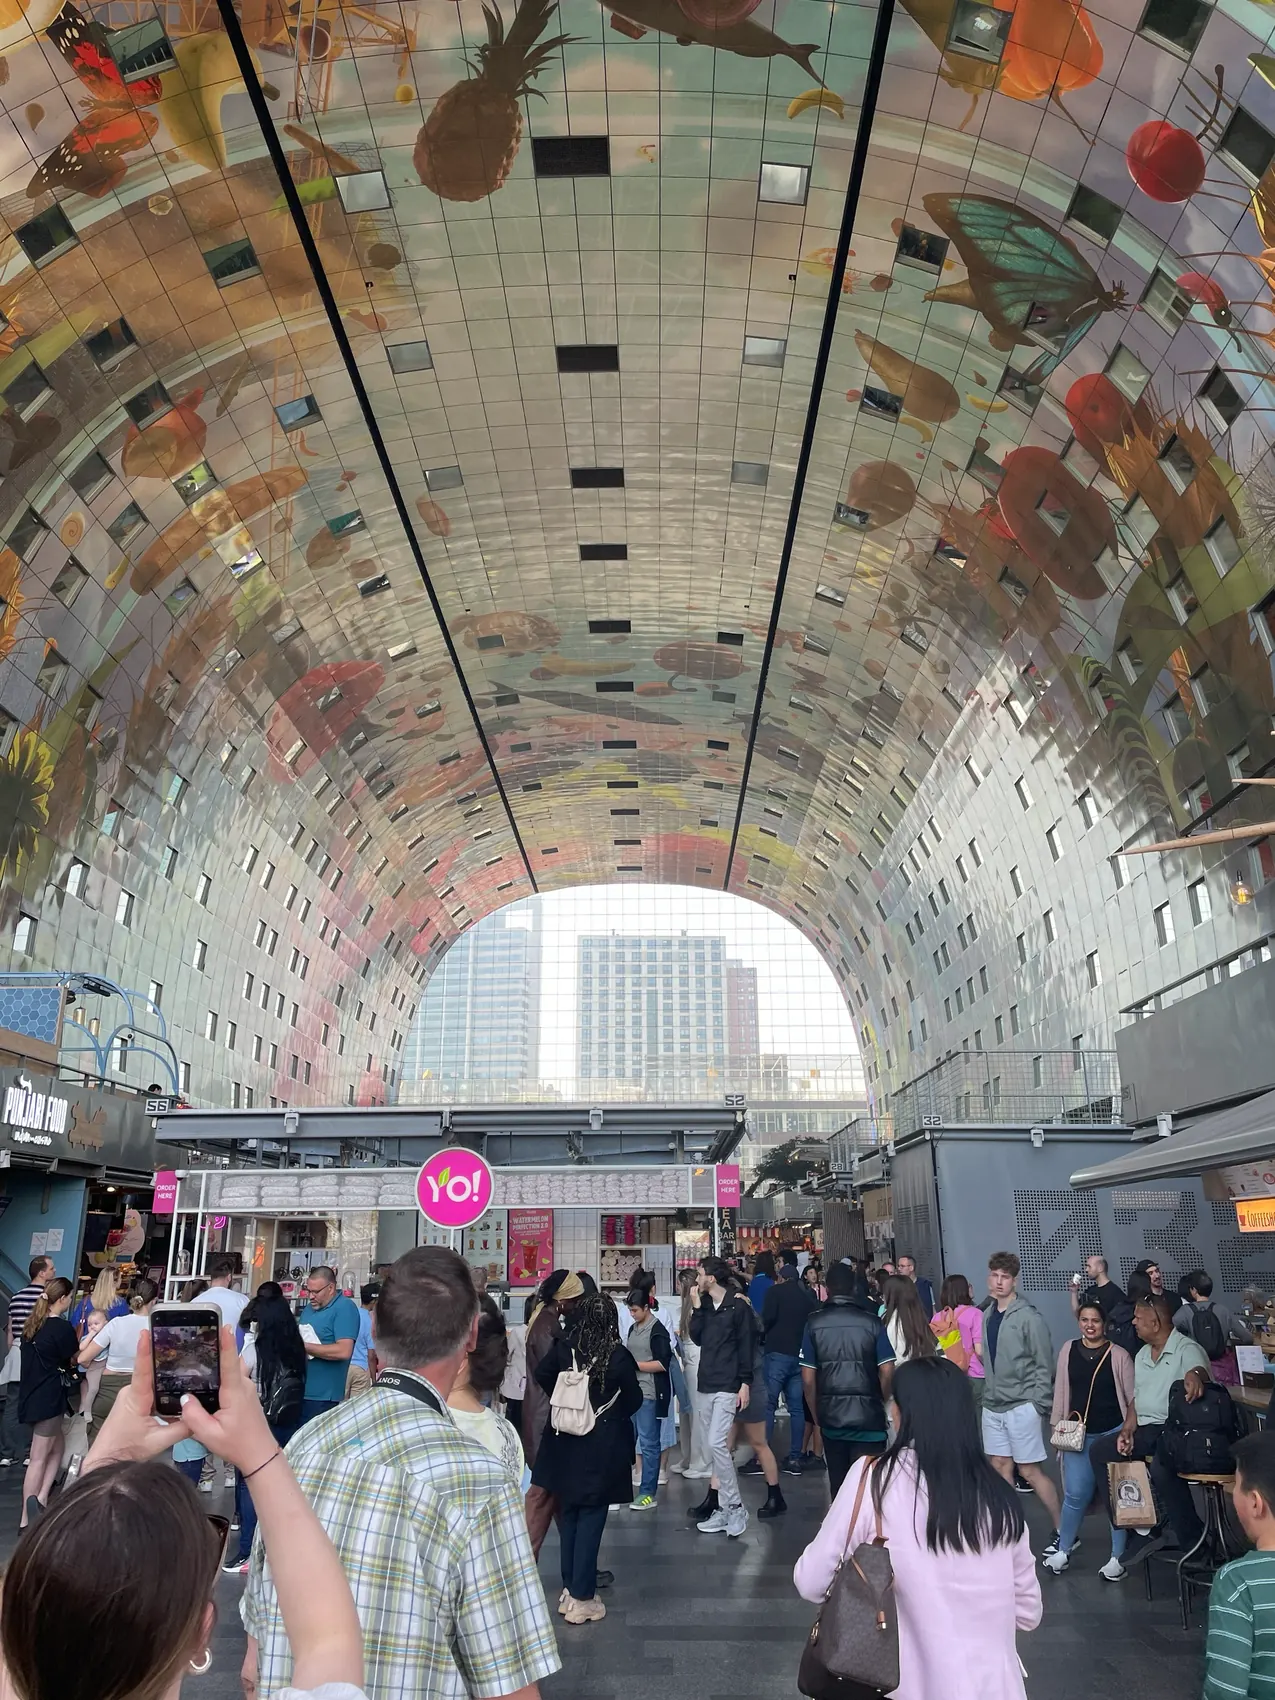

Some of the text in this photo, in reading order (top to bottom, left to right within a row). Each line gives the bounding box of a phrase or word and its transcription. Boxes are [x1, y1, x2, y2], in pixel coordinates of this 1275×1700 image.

[725, 1095, 744, 1106] 52
[4, 1086, 68, 1134] PUNJABI FOOD
[147, 1101, 167, 1112] 56
[923, 1116, 941, 1126] 32
[831, 1163, 842, 1171] 28
[426, 1168, 482, 1203] YO!
[512, 1216, 549, 1224] WATERMELON
[722, 1207, 732, 1230] EA
[1247, 1210, 1275, 1228] COFFEESH
